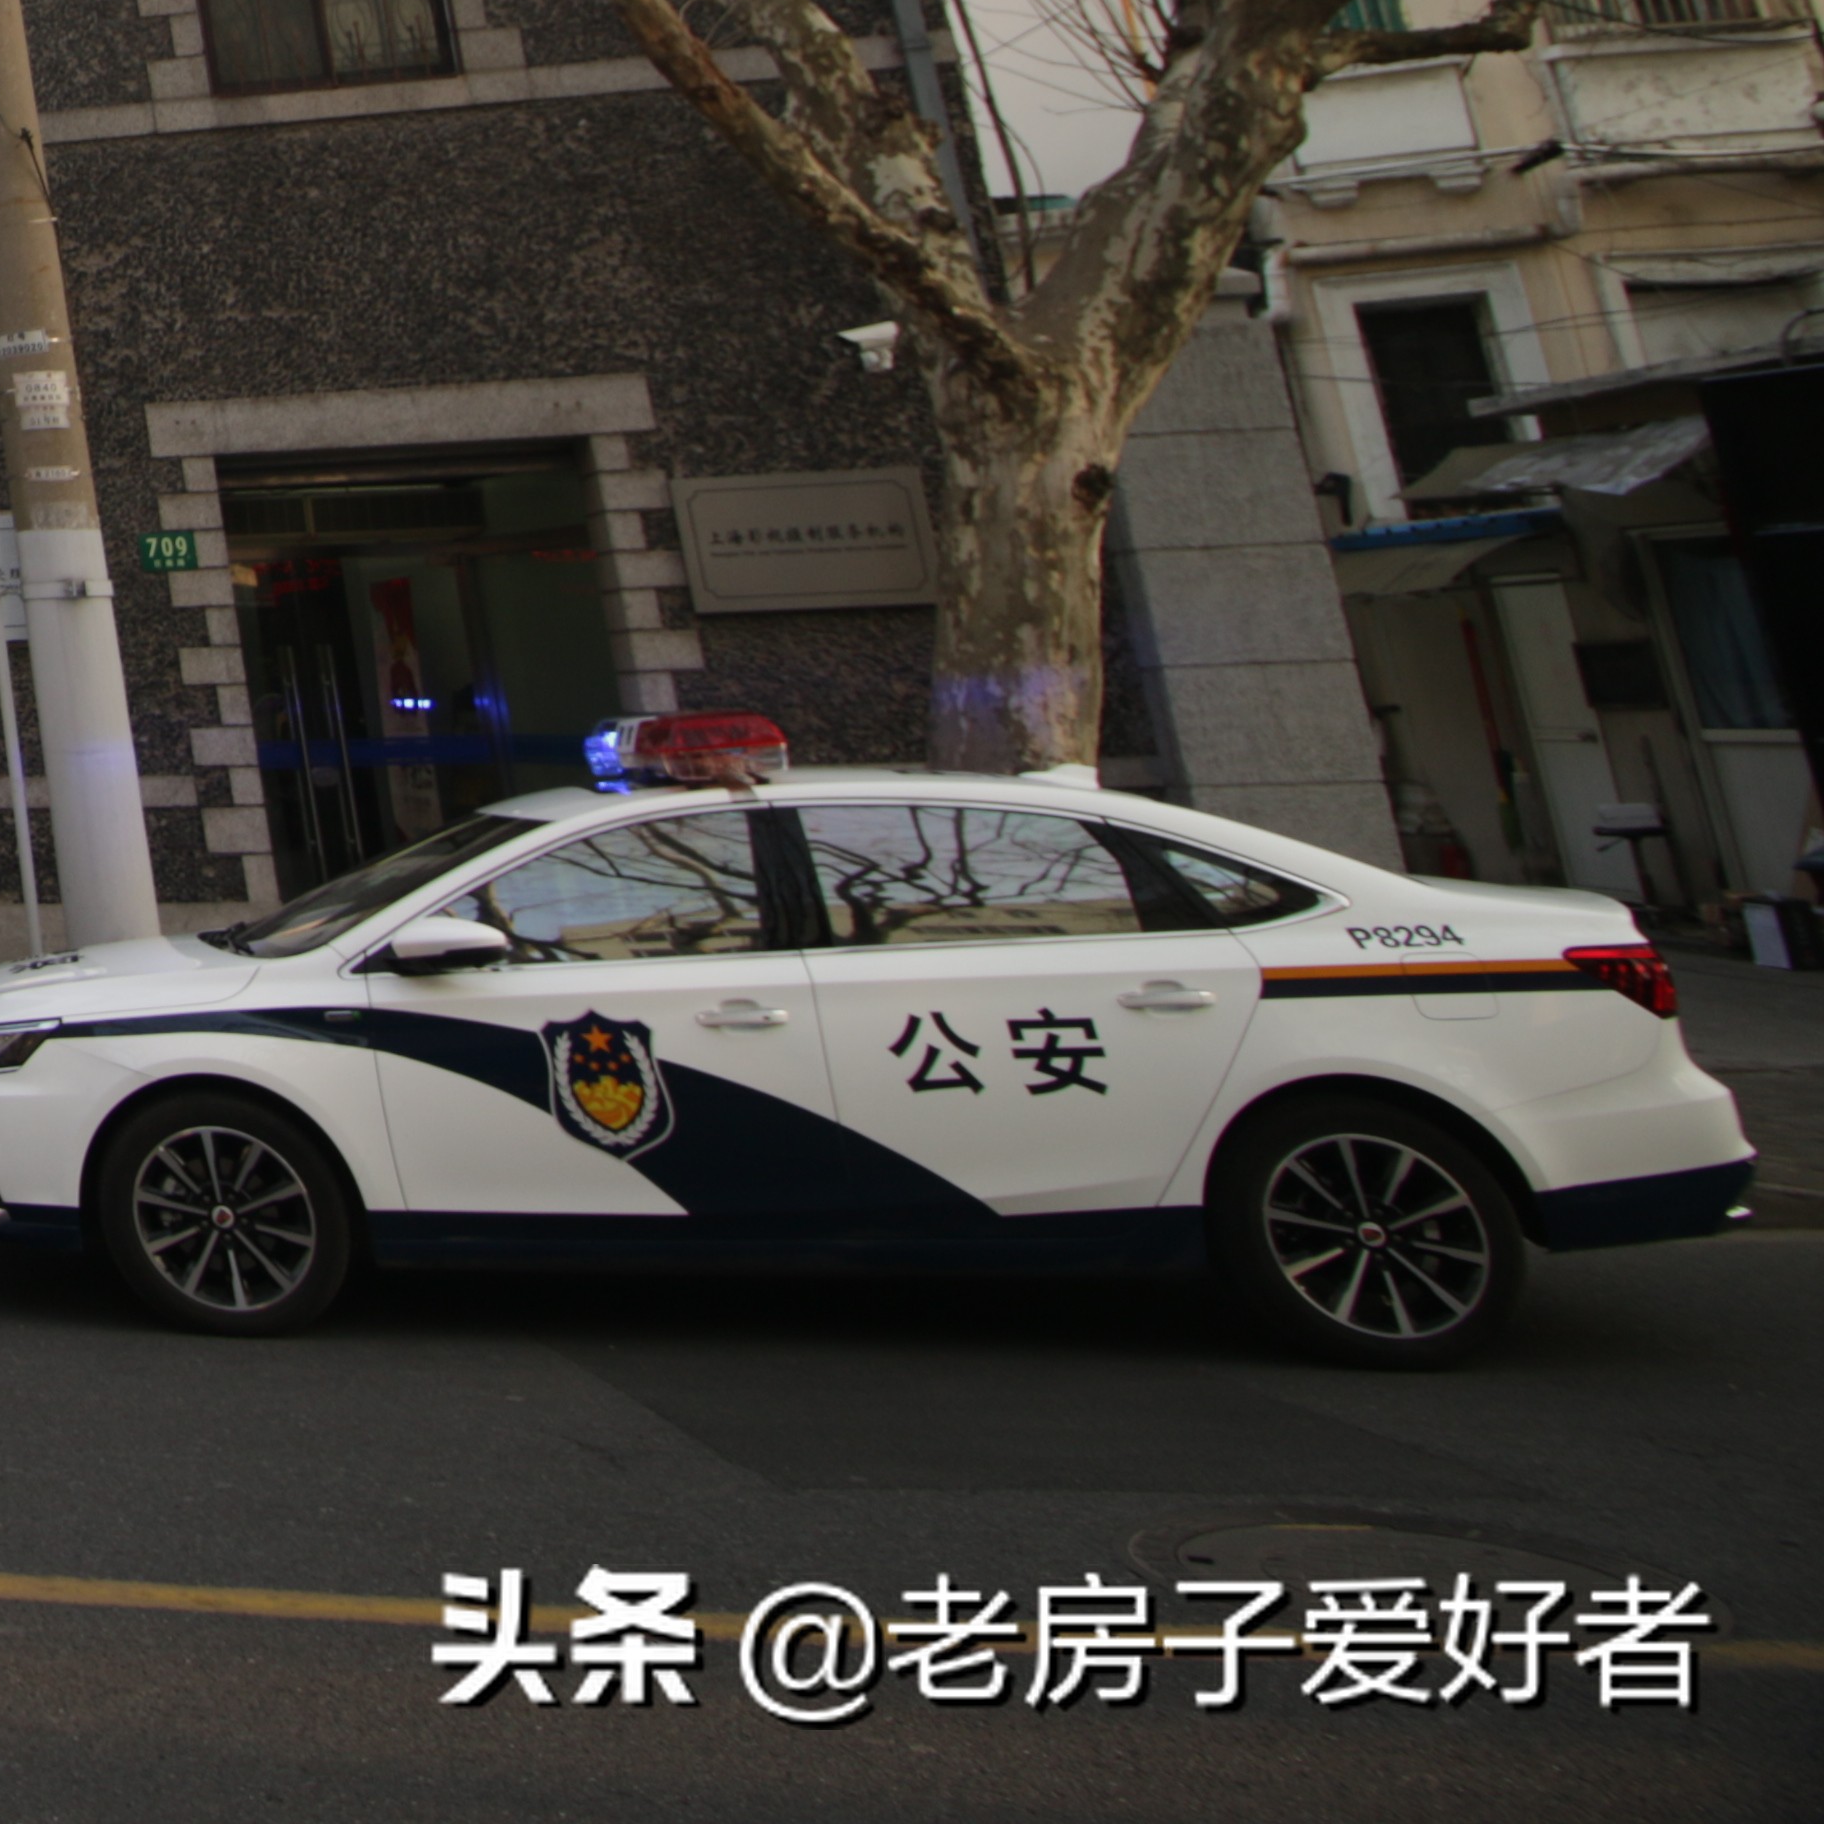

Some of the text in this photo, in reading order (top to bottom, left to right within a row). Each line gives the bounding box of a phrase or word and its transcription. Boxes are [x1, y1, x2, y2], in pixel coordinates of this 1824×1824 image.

[146, 536, 188, 558] 709
[1346, 925, 1465, 949] P8294
[887, 1007, 1108, 1095] 公安
